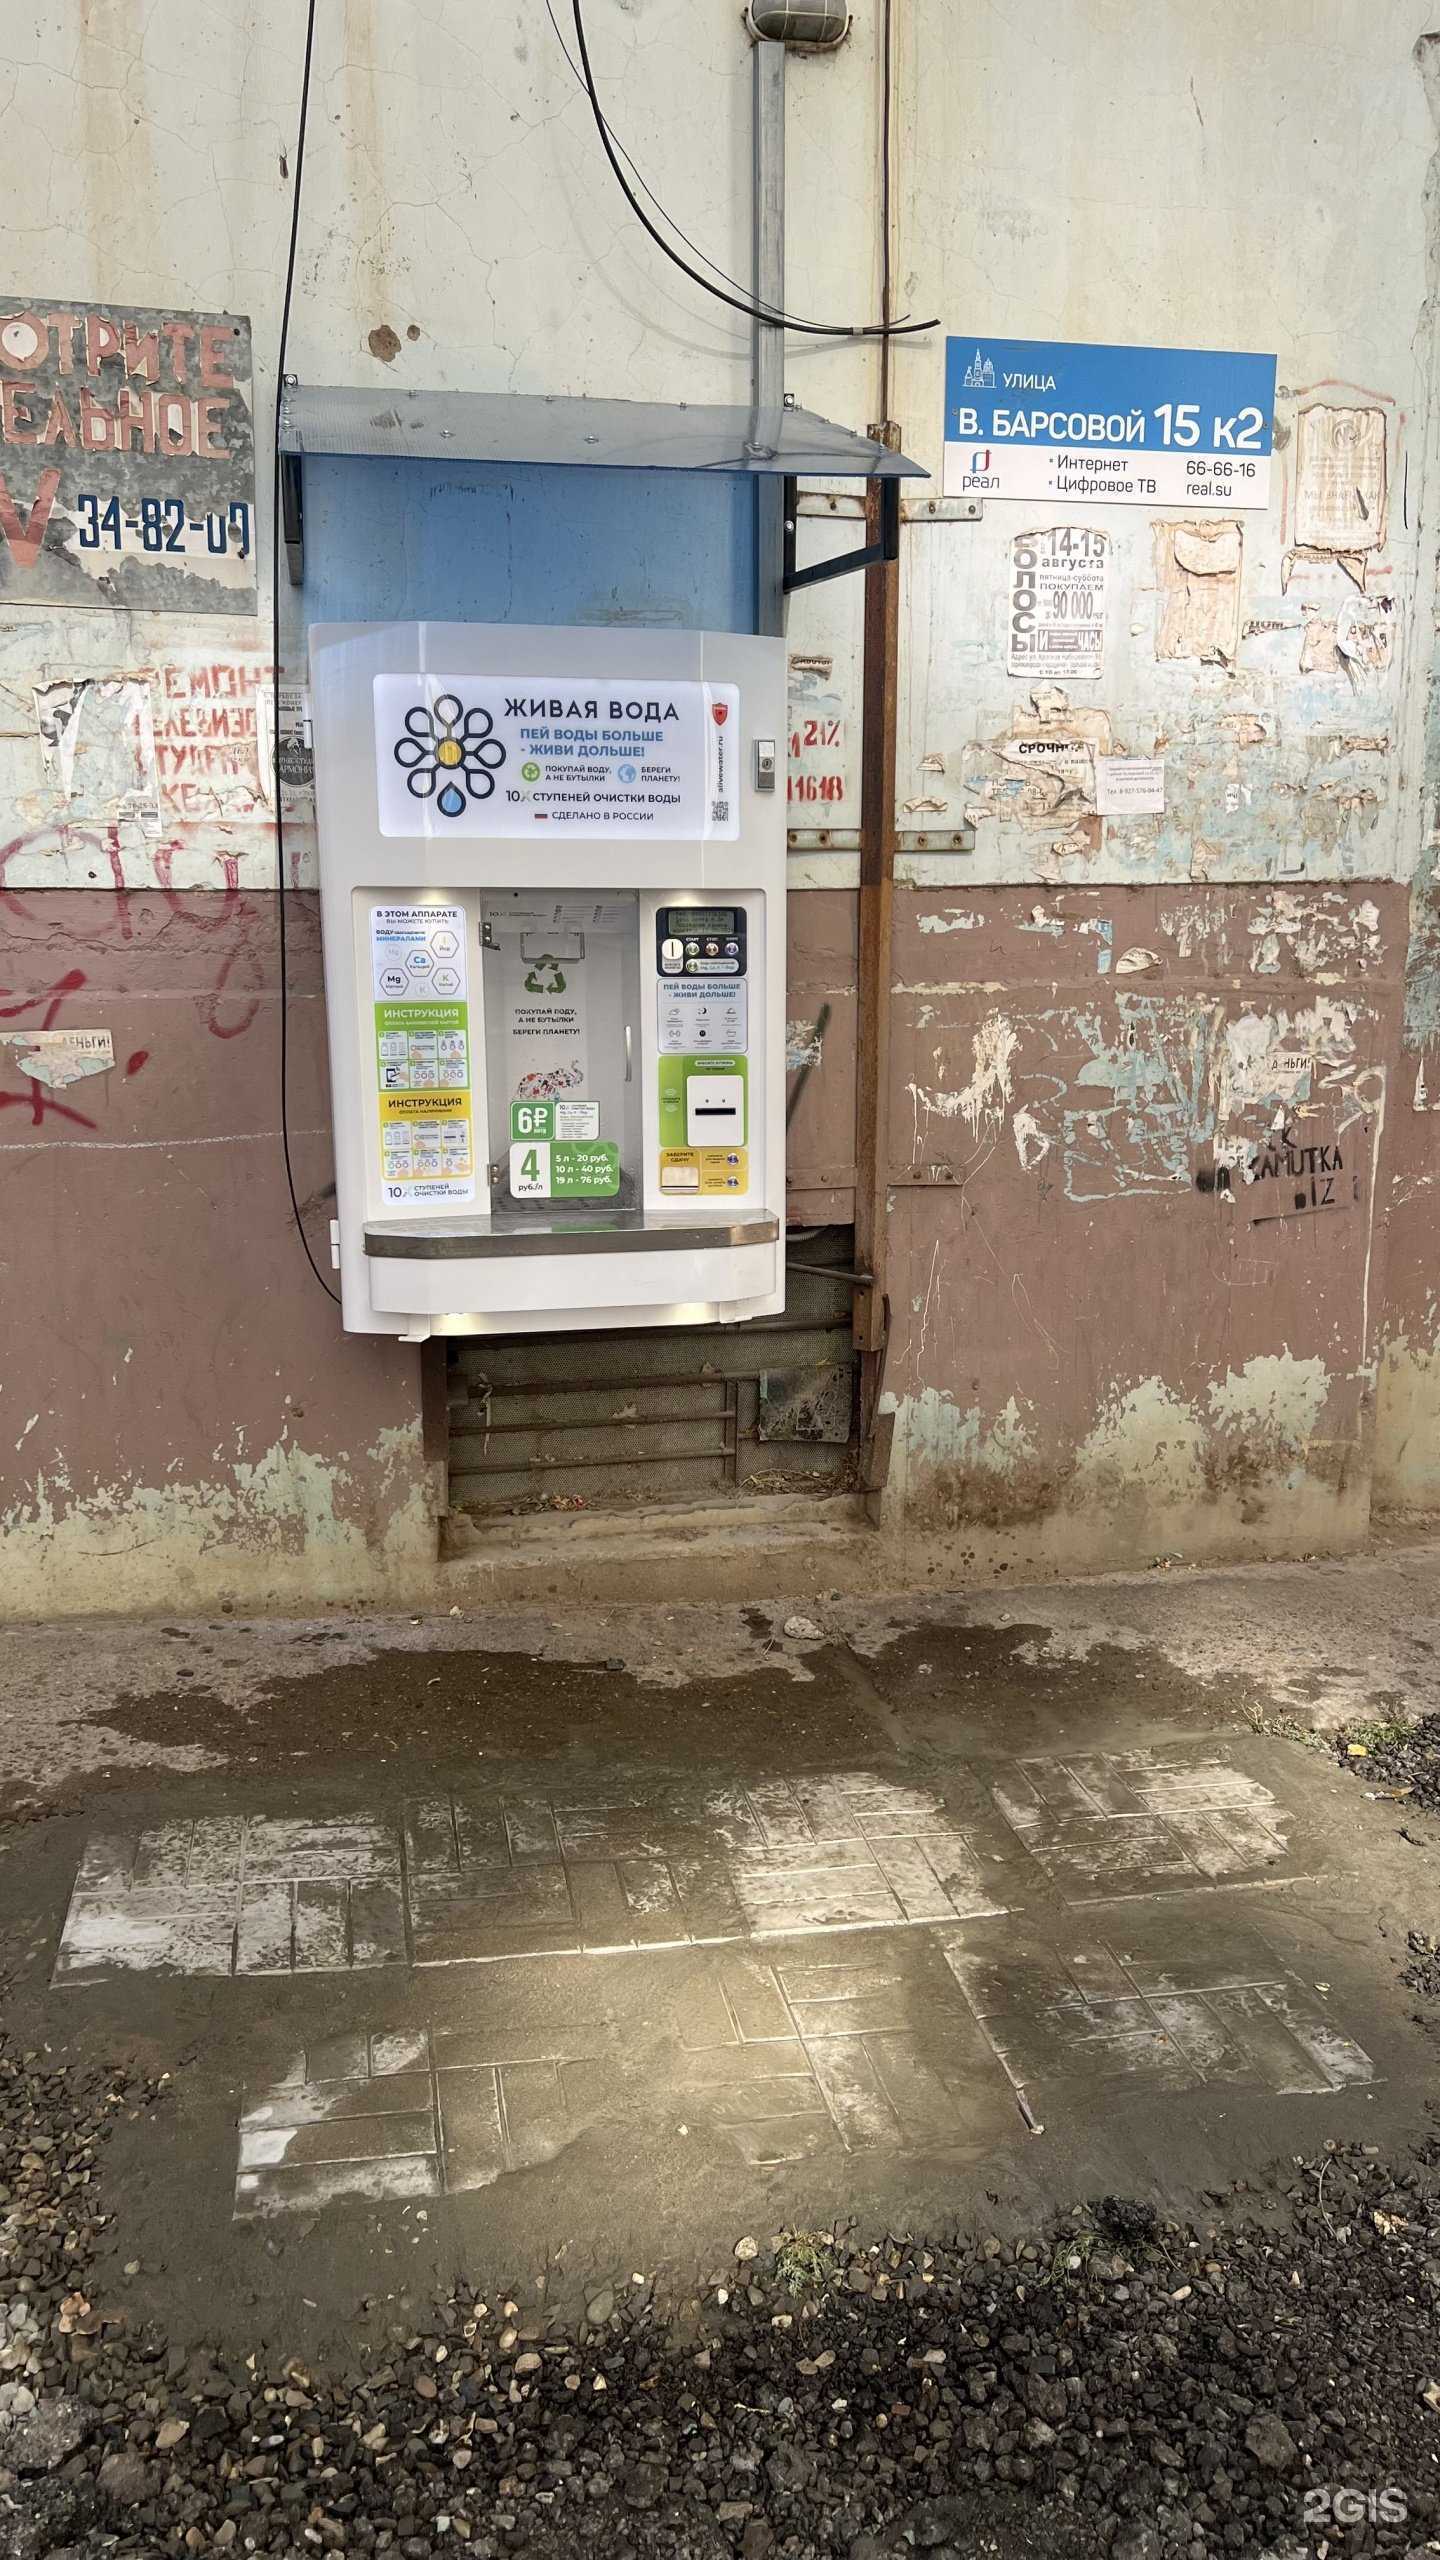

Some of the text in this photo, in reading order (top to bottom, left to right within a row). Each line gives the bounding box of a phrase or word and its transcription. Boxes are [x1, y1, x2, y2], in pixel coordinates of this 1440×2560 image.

[1003, 372, 1056, 391] УЛИЦА
[959, 407, 983, 436] В.
[992, 409, 1145, 443] БАРСОВОЙ
[1153, 403, 1200, 447] 15
[1057, 455, 1129, 475] Интернет
[1186, 460, 1256, 478] 66-66-16
[962, 473, 1000, 493] реал
[1057, 477, 1156, 495] Цифровое ТВ
[1186, 481, 1232, 497] real.su
[1041, 558, 1104, 571] августа
[1039, 583, 1104, 591] ПОКУПАЕМ
[504, 697, 680, 722] ЖИВАЯ ВОДА
[520, 726, 664, 742] ПЕЙ ВОДЫ БОЛЬШЕ
[530, 744, 574, 756] ЖИВИ
[578, 745, 645, 757] ДОЛЬШЕ!
[545, 764, 586, 773] ПОКУПАЙ
[532, 791, 591, 802] СТУПЕНЕЙ
[593, 793, 645, 803] ОЧИСТКИ
[648, 794, 681, 804] ВОДЫ
[552, 811, 654, 820] СДЕЛАНО В РОССИИ
[385, 910, 409, 918] ЭТОМ
[411, 910, 458, 918] АППАРАТЕ
[387, 975, 401, 984] Mg
[663, 982, 680, 991] ПЕЙ
[384, 1008, 460, 1019] ИНСТРУКЦИЯ
[1271, 1057, 1311, 1071] ДНЬГИ!
[388, 1097, 463, 1108] ИНСТРУКЦИЯ
[520, 1149, 540, 1181] 4
[555, 1154, 562, 1162] 5
[576, 1154, 589, 1162] 20
[590, 1154, 609, 1164] руб.
[555, 1165, 565, 1173] 10
[580, 1165, 593, 1173] 40
[595, 1165, 614, 1174] руб.
[555, 1176, 566, 1184] 19
[580, 1176, 592, 1184] 76
[594, 1175, 613, 1185] руб.
[518, 1183, 543, 1192] руб./л
